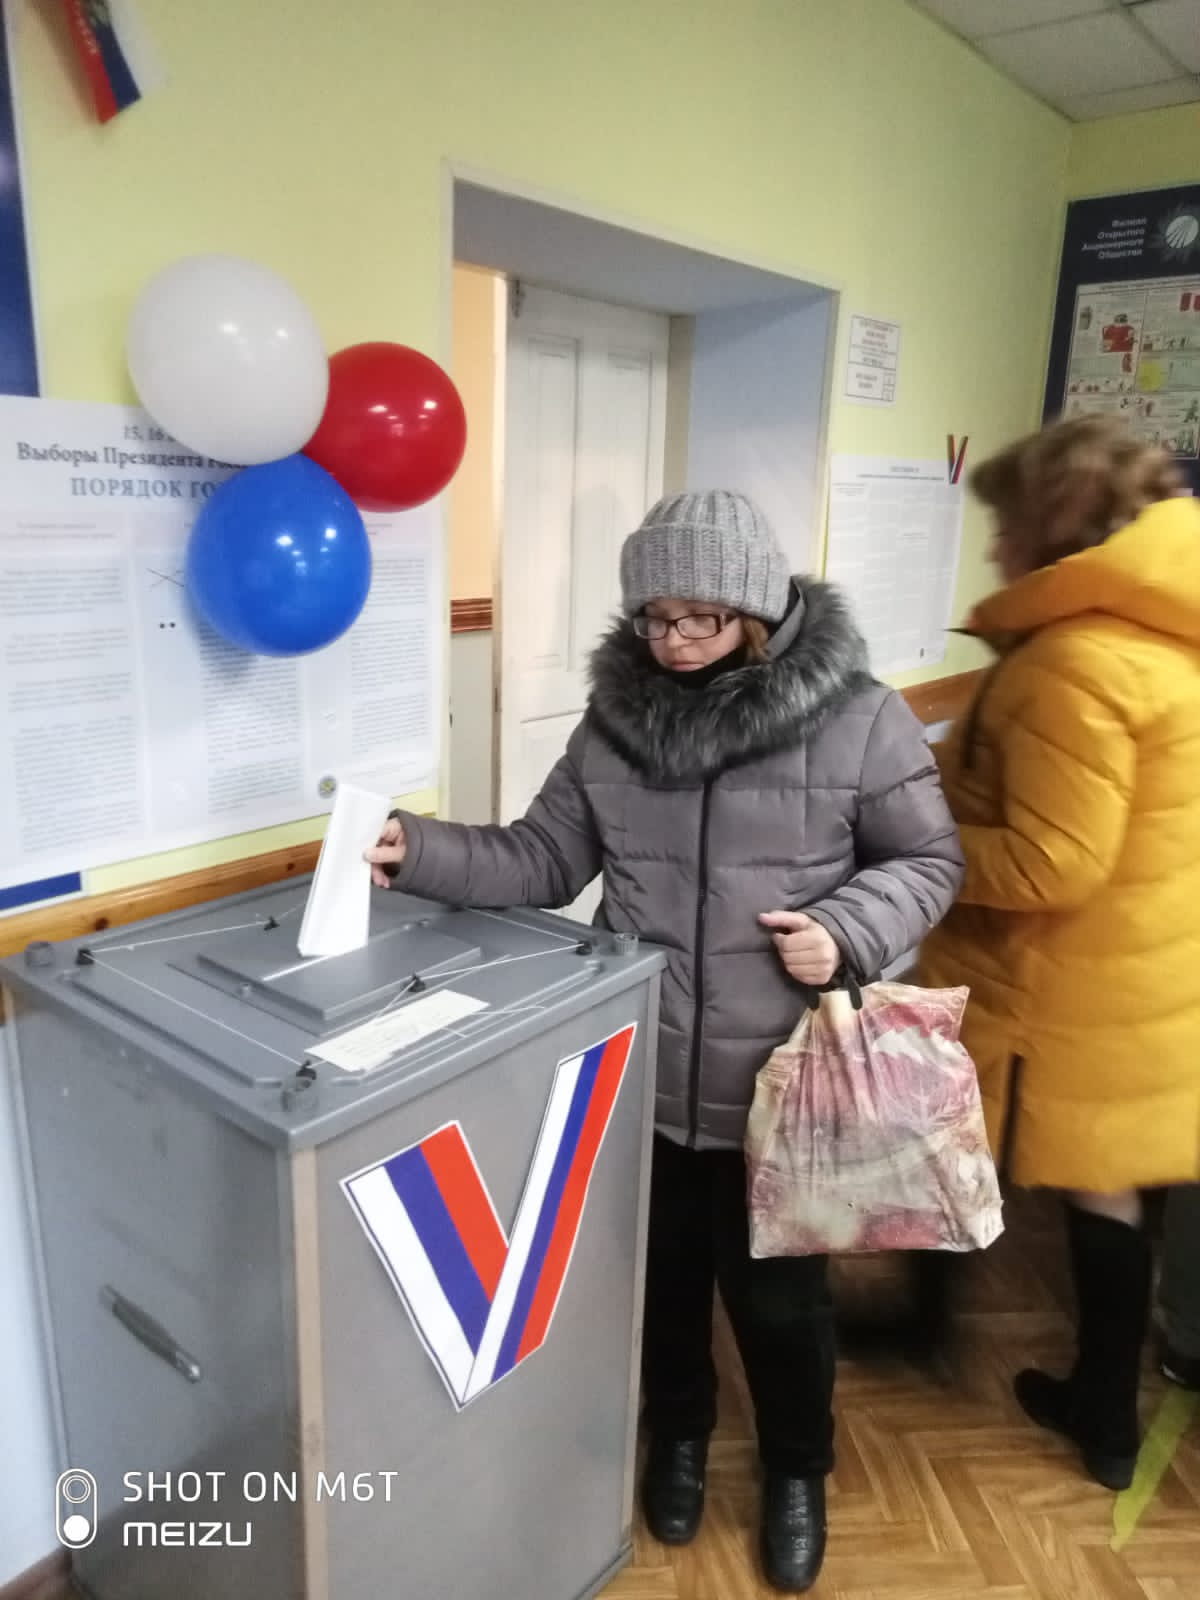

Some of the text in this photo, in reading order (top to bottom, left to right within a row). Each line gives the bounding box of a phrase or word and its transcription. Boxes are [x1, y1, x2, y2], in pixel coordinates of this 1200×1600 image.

[17, 441, 97, 468] Выборы
[103, 446, 203, 470] Президента
[70, 477, 182, 499] ПОРЯДОК
